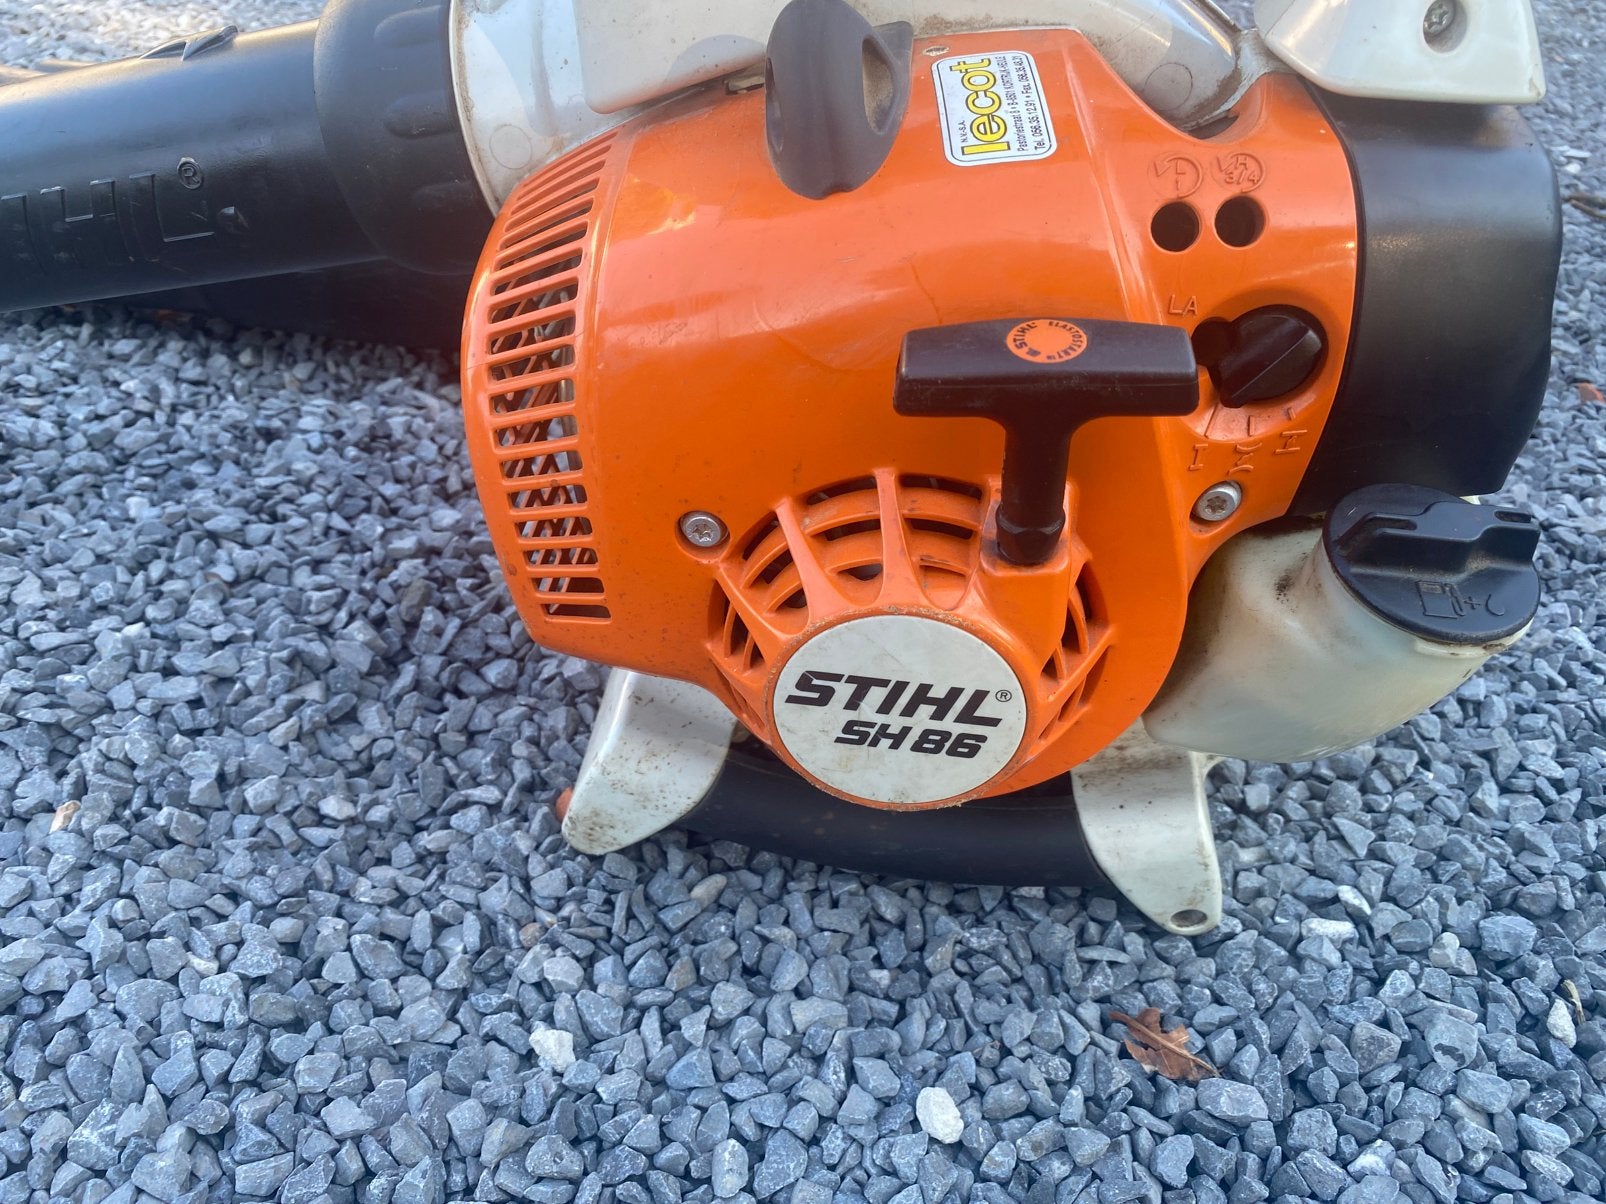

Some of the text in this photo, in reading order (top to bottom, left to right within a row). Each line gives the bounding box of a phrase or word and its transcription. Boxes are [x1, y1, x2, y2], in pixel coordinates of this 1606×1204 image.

[949, 58, 1011, 156] lecot
[1032, 138, 1047, 151] Tel.
[1168, 294, 1199, 317] LA
[833, 719, 988, 759] SH 86
